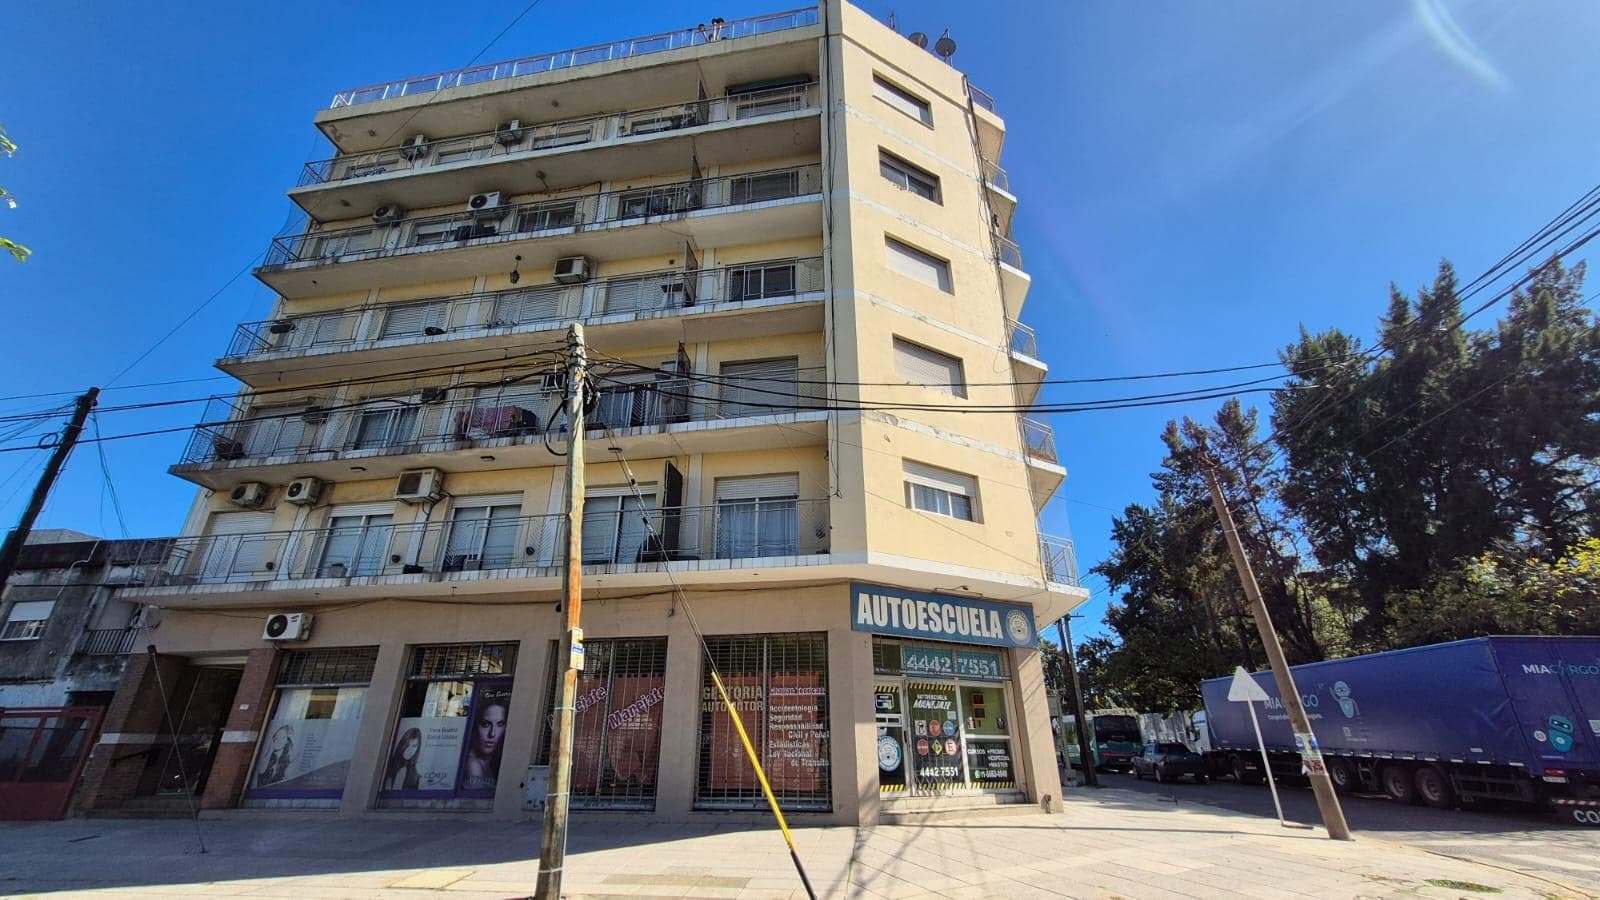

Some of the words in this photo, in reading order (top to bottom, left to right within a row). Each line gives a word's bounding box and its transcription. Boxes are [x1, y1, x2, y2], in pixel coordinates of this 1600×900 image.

[857, 592, 1004, 639] AUTOESCUELA
[906, 654, 952, 673] 4442
[957, 658, 998, 676] 7551
[543, 686, 606, 730] Mejate
[1264, 694, 1319, 710] MIAGO
[769, 714, 803, 722] Seguridad
[1573, 809, 1600, 824] CO
